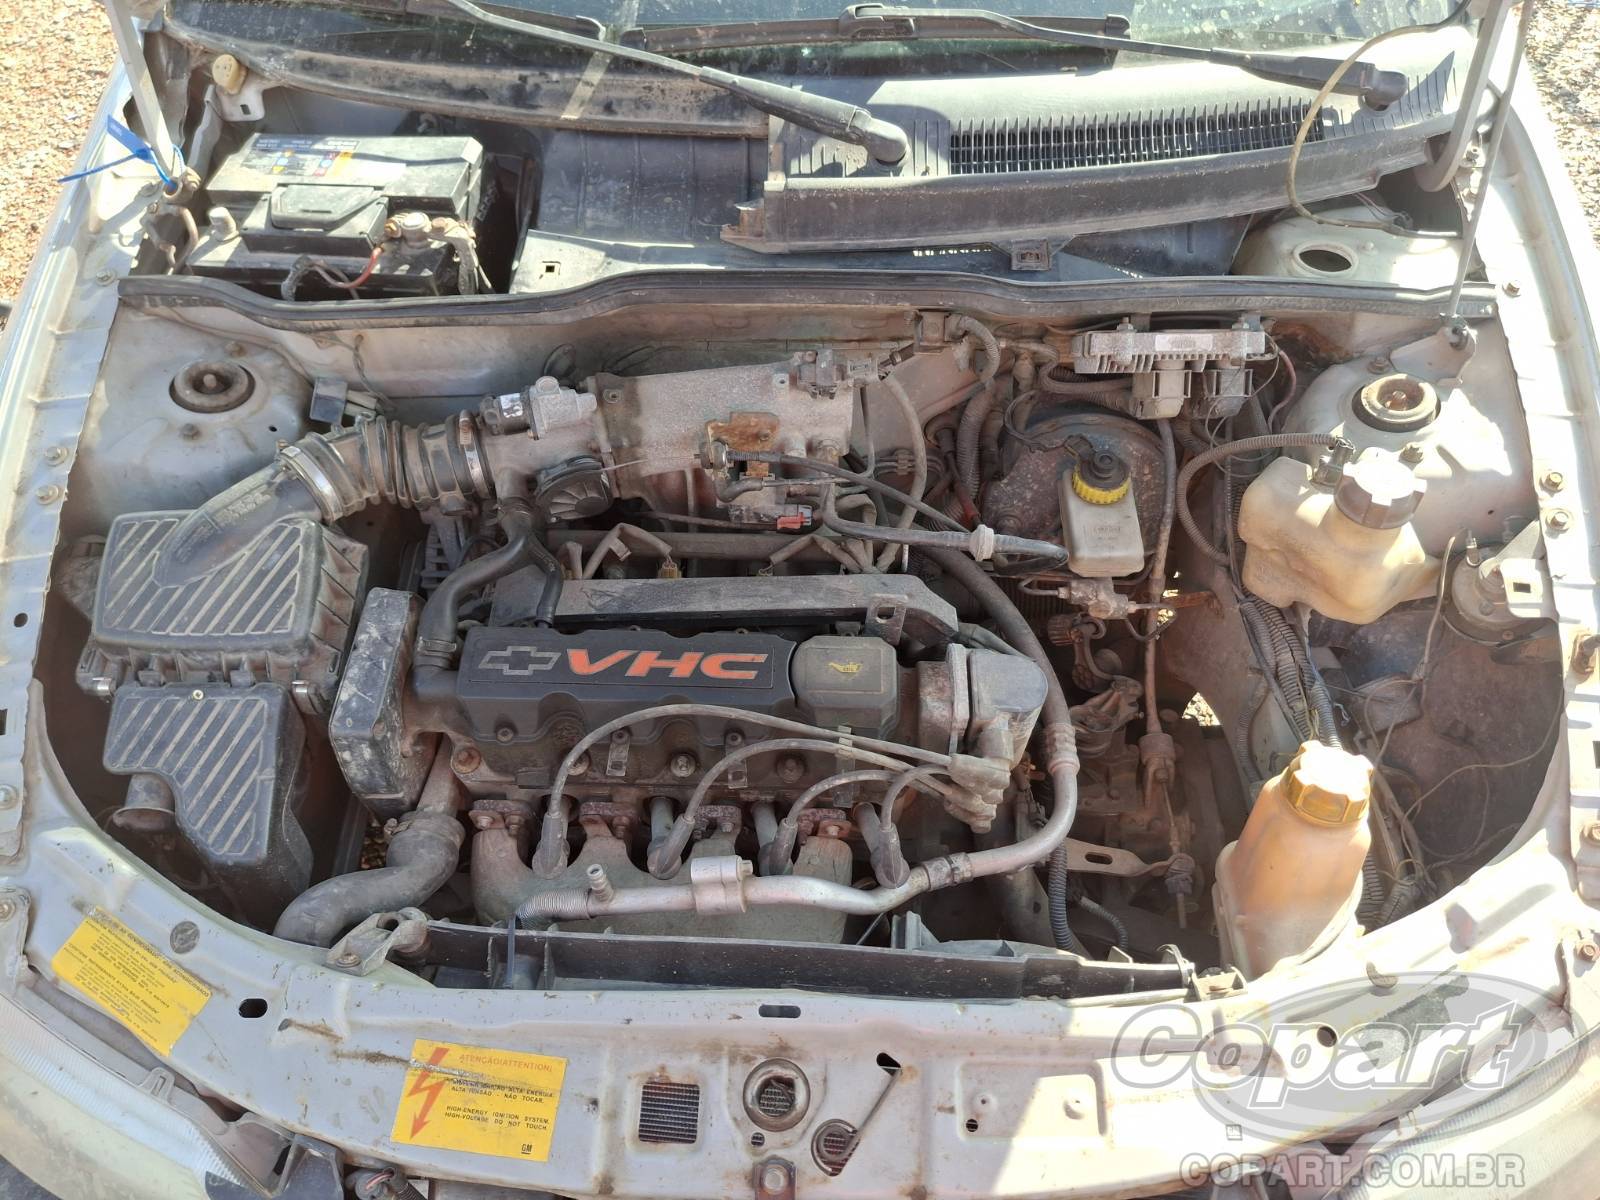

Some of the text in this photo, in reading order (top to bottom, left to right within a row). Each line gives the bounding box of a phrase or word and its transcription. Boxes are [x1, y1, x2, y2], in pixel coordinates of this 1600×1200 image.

[566, 648, 768, 680] VHC
[507, 1120, 521, 1128] NOT
[521, 1143, 533, 1154] GM
